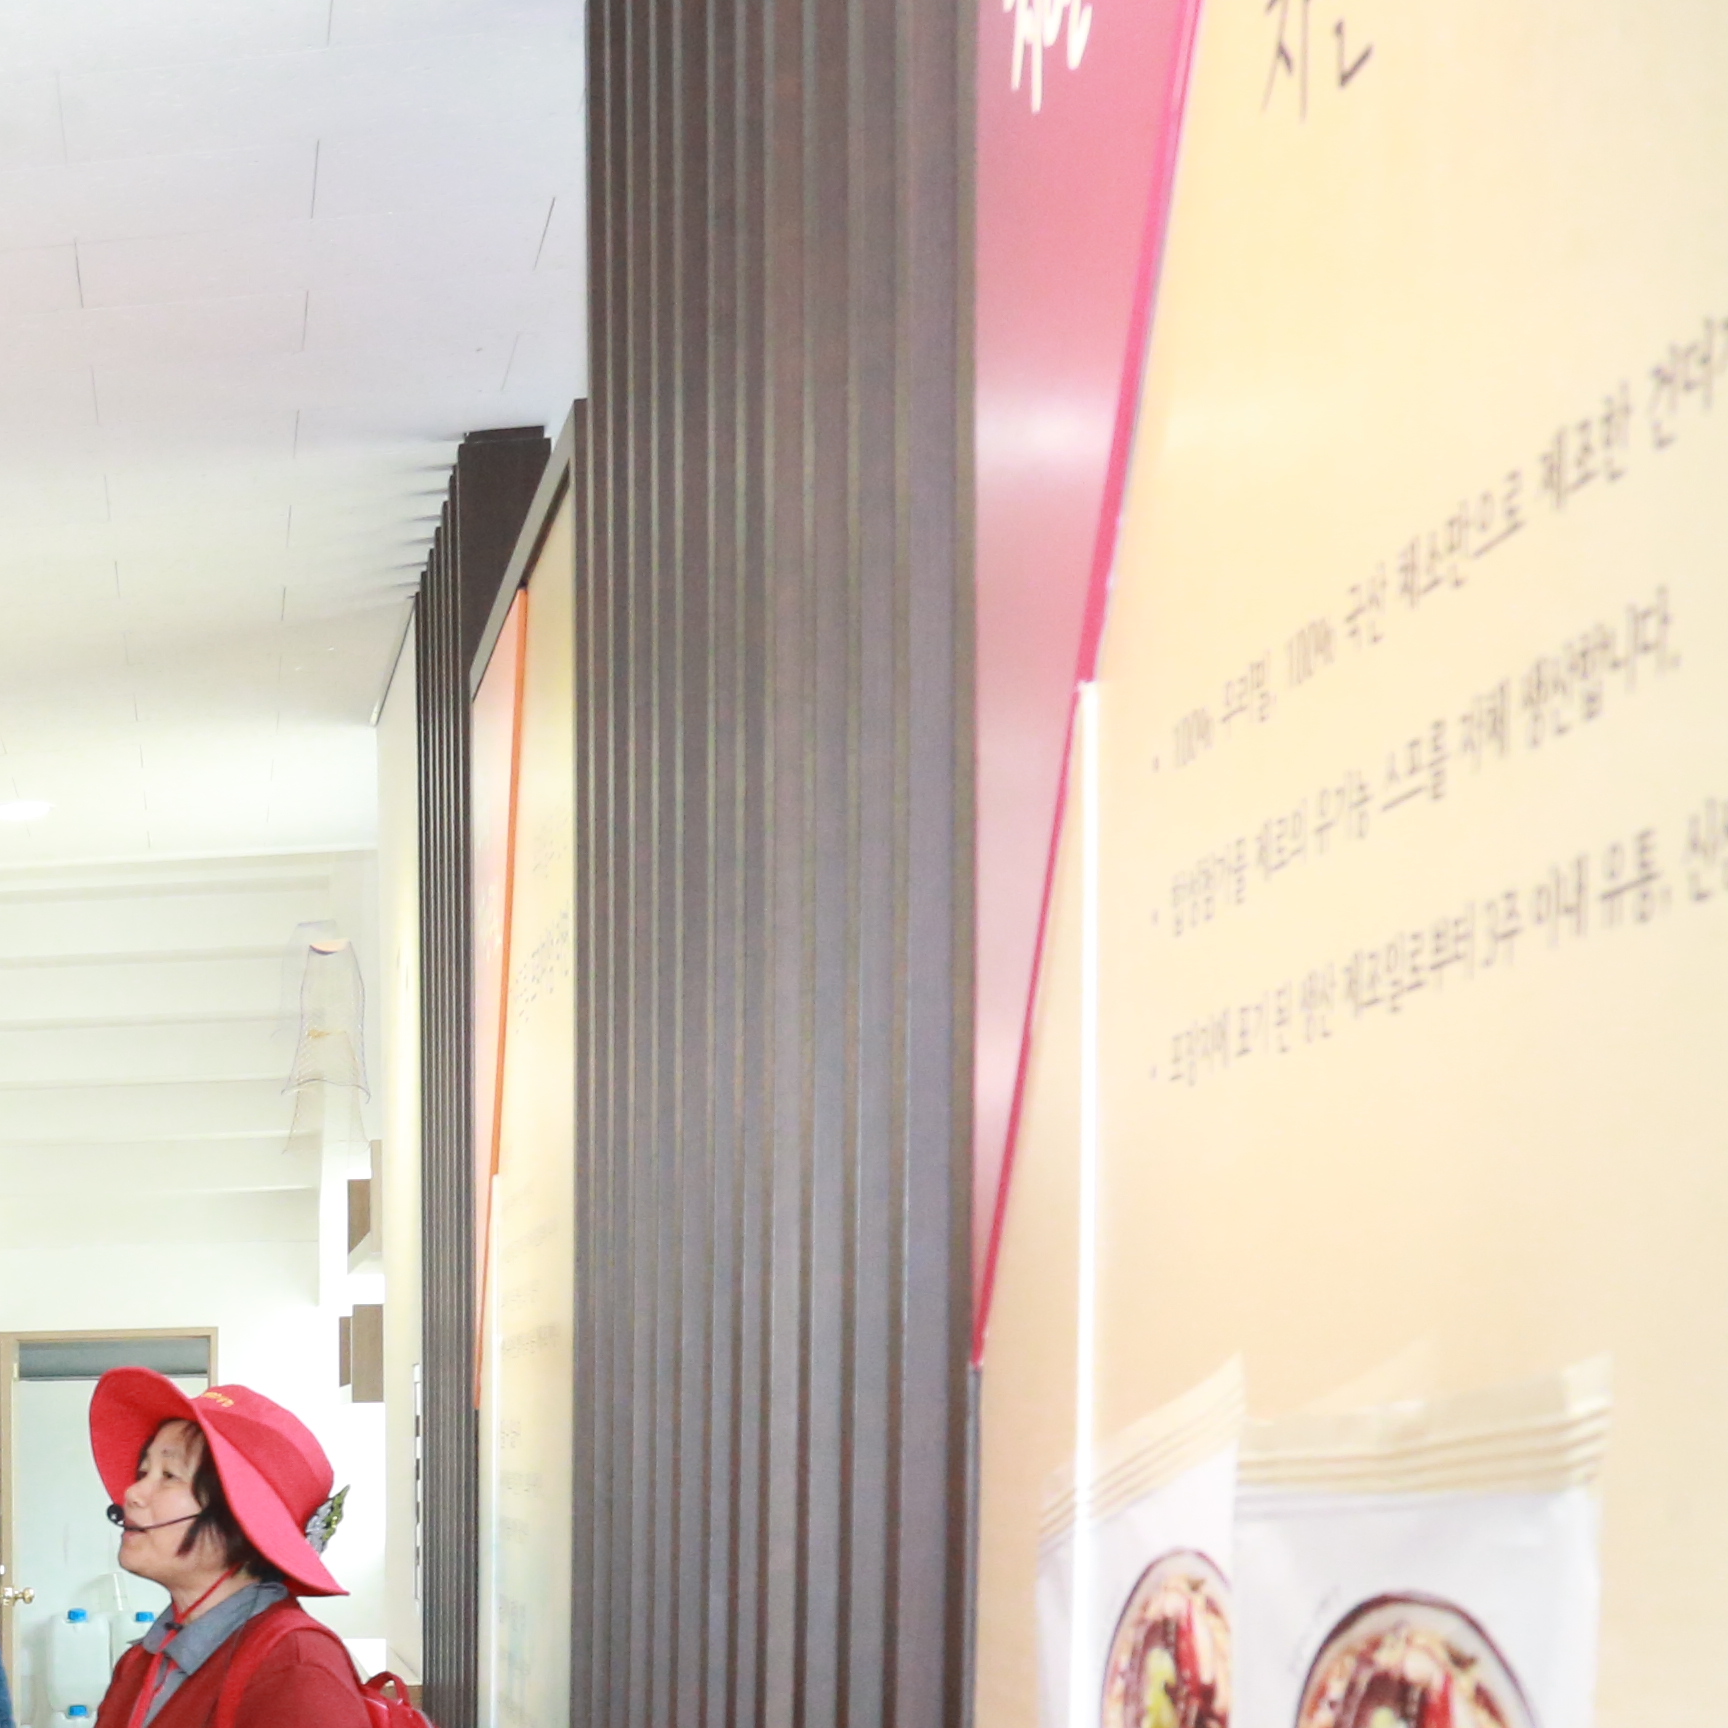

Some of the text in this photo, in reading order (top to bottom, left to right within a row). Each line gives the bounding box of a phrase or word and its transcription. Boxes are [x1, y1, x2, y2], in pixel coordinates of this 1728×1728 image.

[1649, 315, 1728, 451] 건더
[1314, 769, 1374, 855] 유기농
[1382, 719, 1448, 812] 스프를
